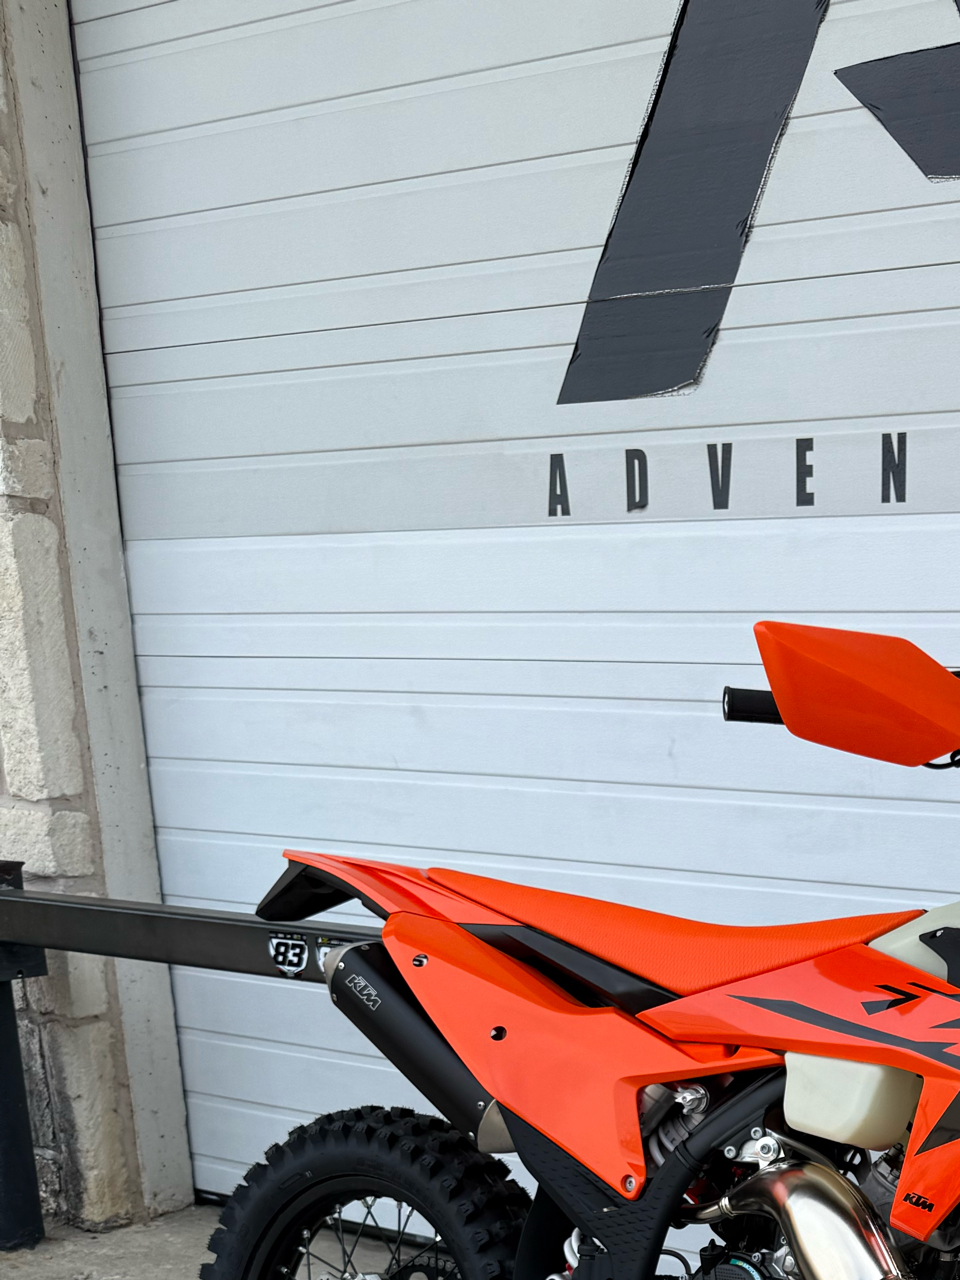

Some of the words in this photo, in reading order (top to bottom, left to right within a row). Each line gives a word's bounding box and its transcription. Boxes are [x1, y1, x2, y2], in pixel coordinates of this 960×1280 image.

[274, 942, 305, 967] 83
[345, 973, 382, 1011] KTM
[902, 1192, 935, 1213] KTM
